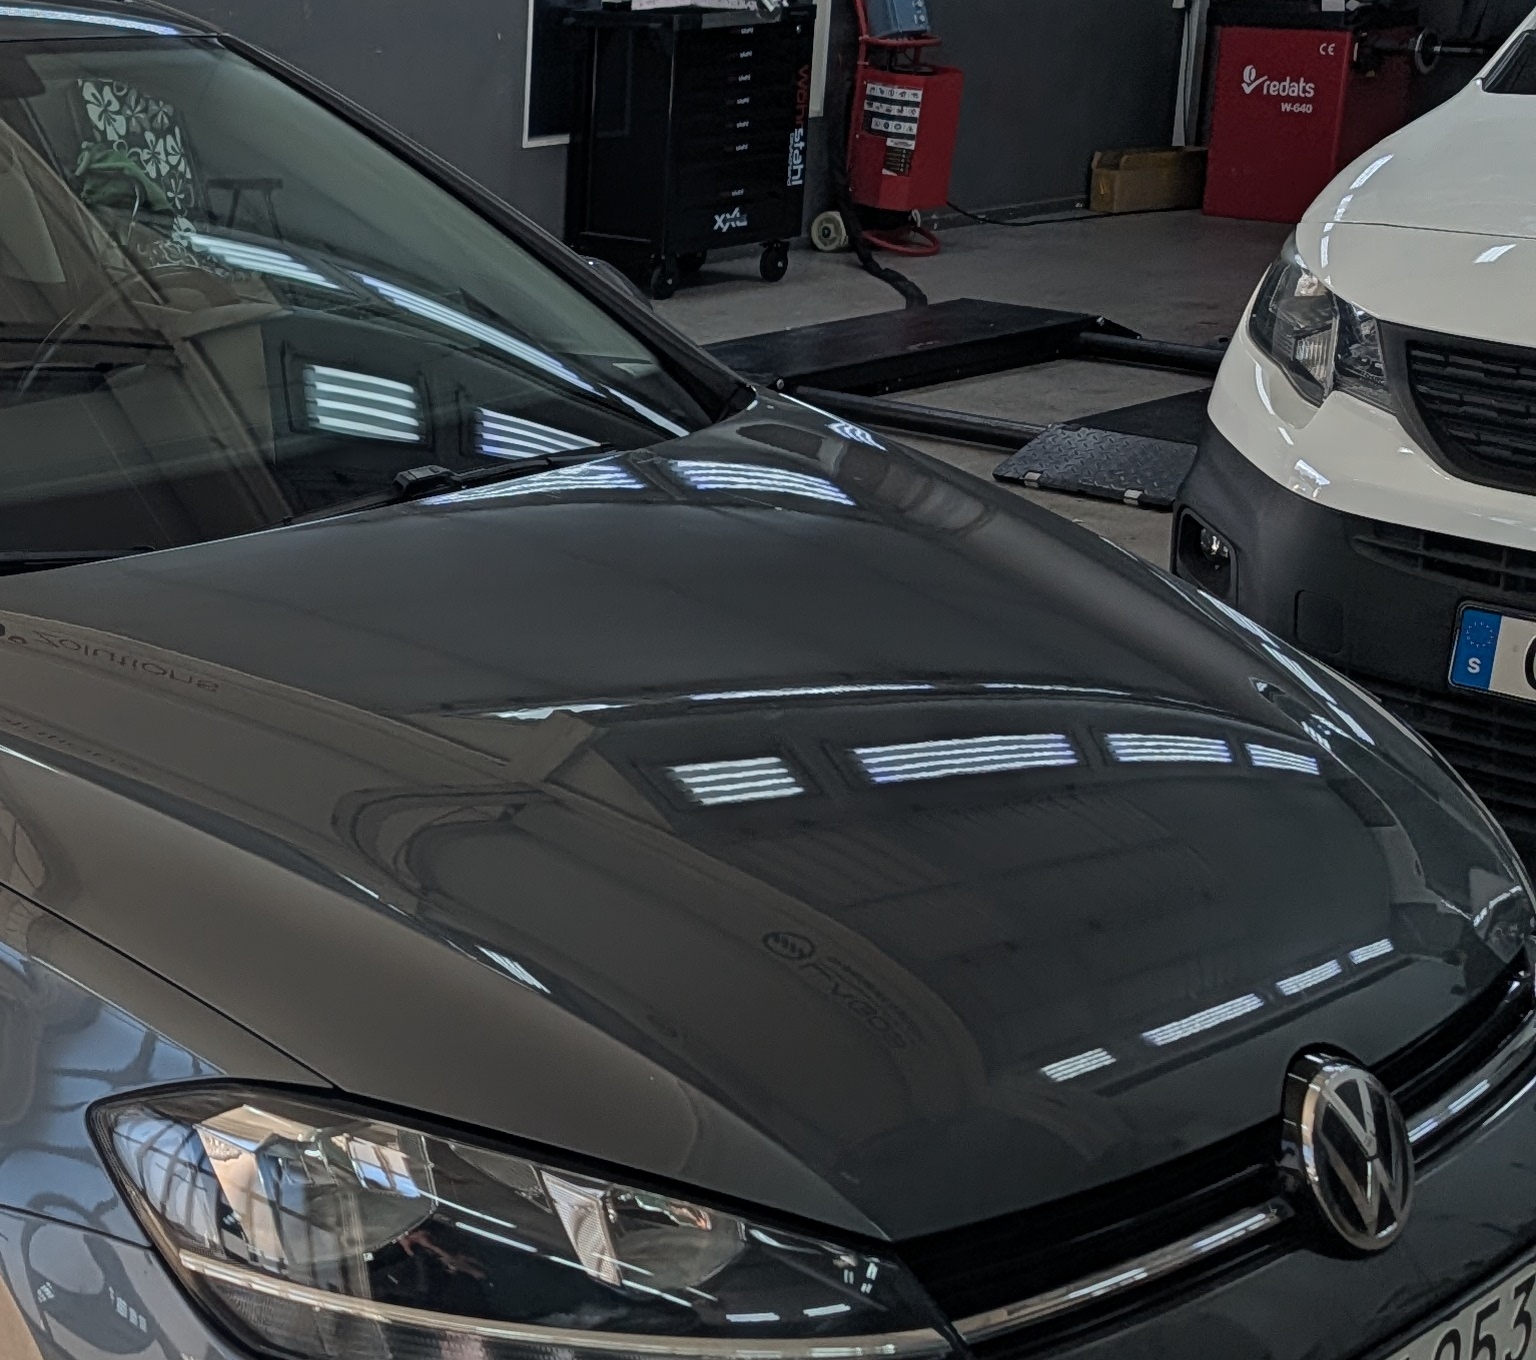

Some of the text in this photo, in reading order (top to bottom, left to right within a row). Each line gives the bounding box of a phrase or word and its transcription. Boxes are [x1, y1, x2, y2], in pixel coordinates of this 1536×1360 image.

[1262, 75, 1316, 99] redats
[1280, 102, 1314, 114] W-640
[1466, 657, 1482, 674] S
